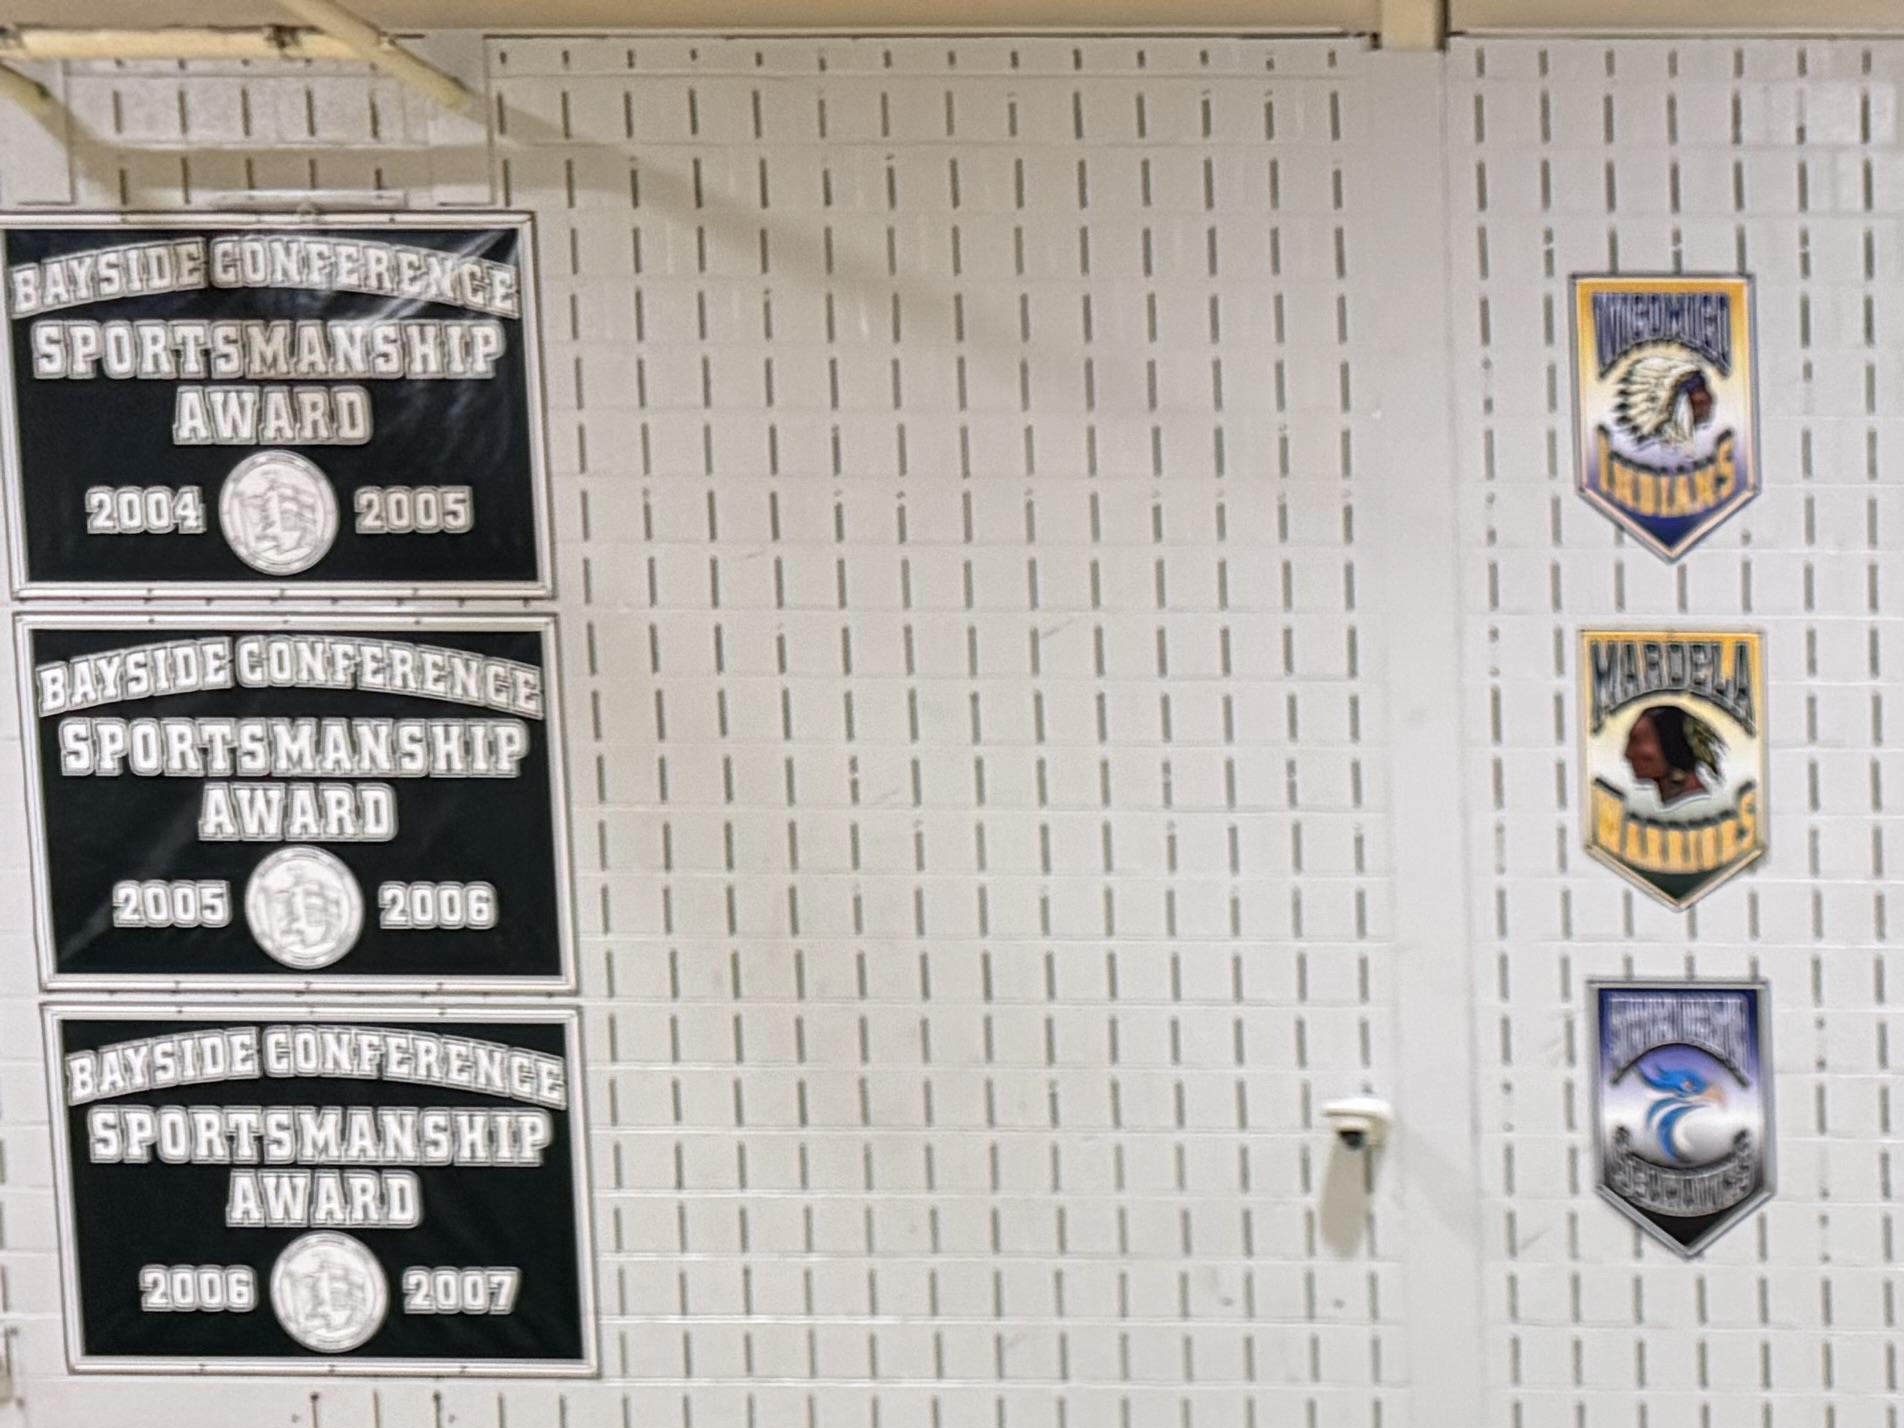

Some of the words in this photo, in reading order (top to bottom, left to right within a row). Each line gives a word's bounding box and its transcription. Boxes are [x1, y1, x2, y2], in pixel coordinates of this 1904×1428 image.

[11, 236, 207, 315] BAYSIDE
[209, 235, 518, 318] CONFERENCE
[31, 319, 503, 378] SPORTSMANSHIP
[172, 386, 373, 445] AWARD
[86, 486, 206, 534] 2004
[354, 486, 473, 534] 2005
[38, 636, 233, 716] BAYSIDE
[236, 635, 544, 719] CONFERENCE
[59, 718, 529, 777] SPORTSMANSHIP
[198, 782, 396, 842] AWARD
[113, 881, 232, 928] 2005
[379, 881, 498, 929] 2006
[67, 1025, 260, 1106] BAYSIDE
[263, 1024, 567, 1110] CONFERENCE
[87, 1106, 552, 1166] SPORTSMANSHIP
[226, 1169, 422, 1228] AWARD
[139, 1264, 257, 1312] 2006
[402, 1267, 521, 1315] 2007
